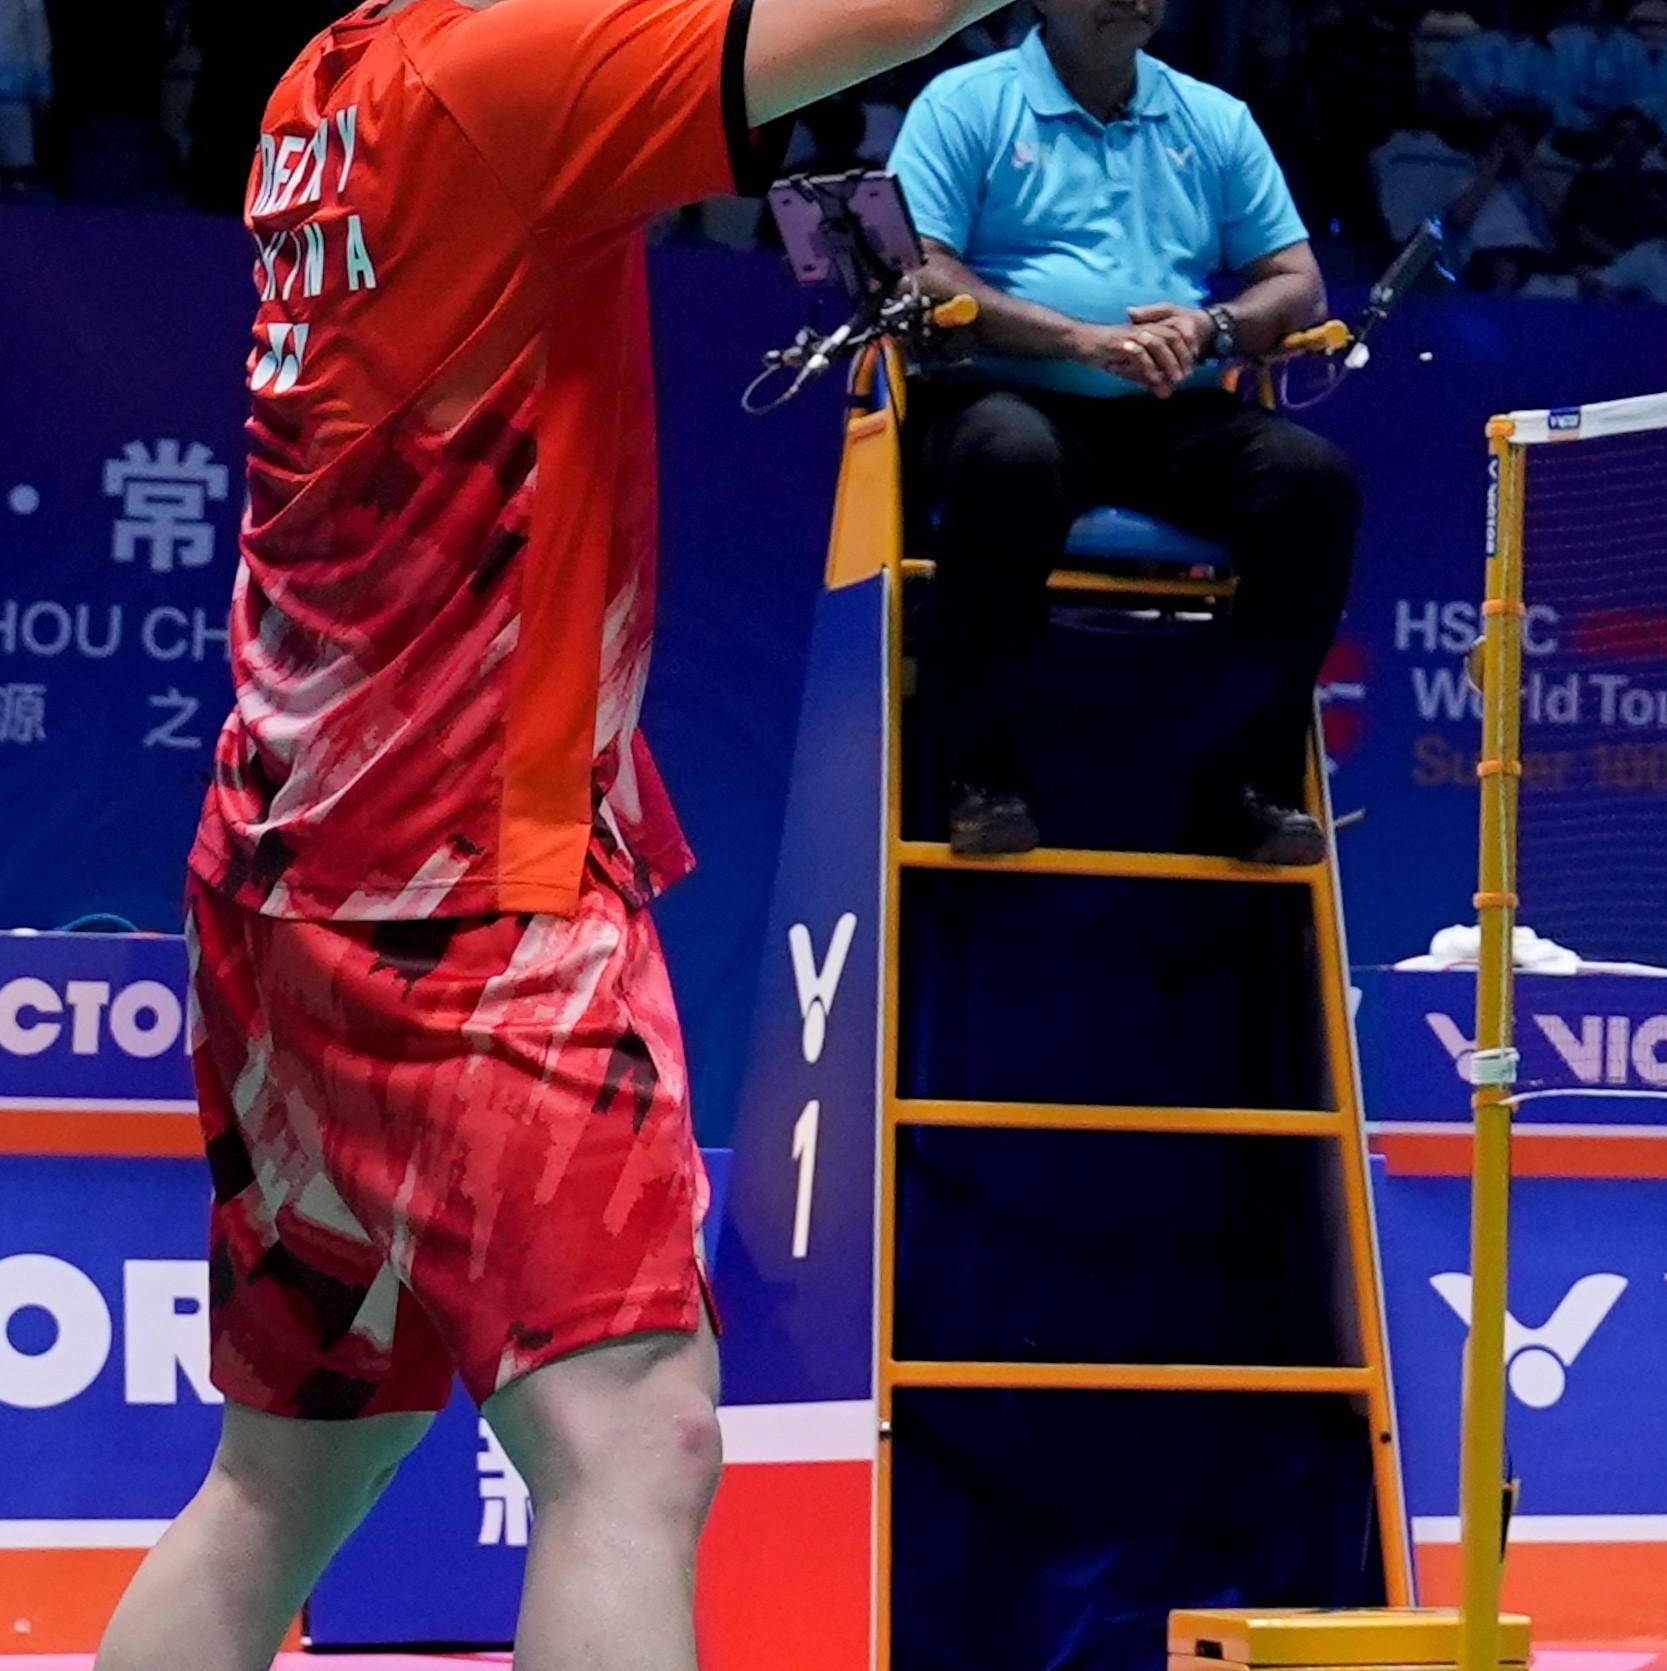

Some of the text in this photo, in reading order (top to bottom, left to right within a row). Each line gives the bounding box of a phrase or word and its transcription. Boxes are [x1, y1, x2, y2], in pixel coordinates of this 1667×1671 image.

[1394, 599, 1560, 657] HSC
[1410, 666, 1580, 724] Wld
[0, 977, 191, 1056] CTO
